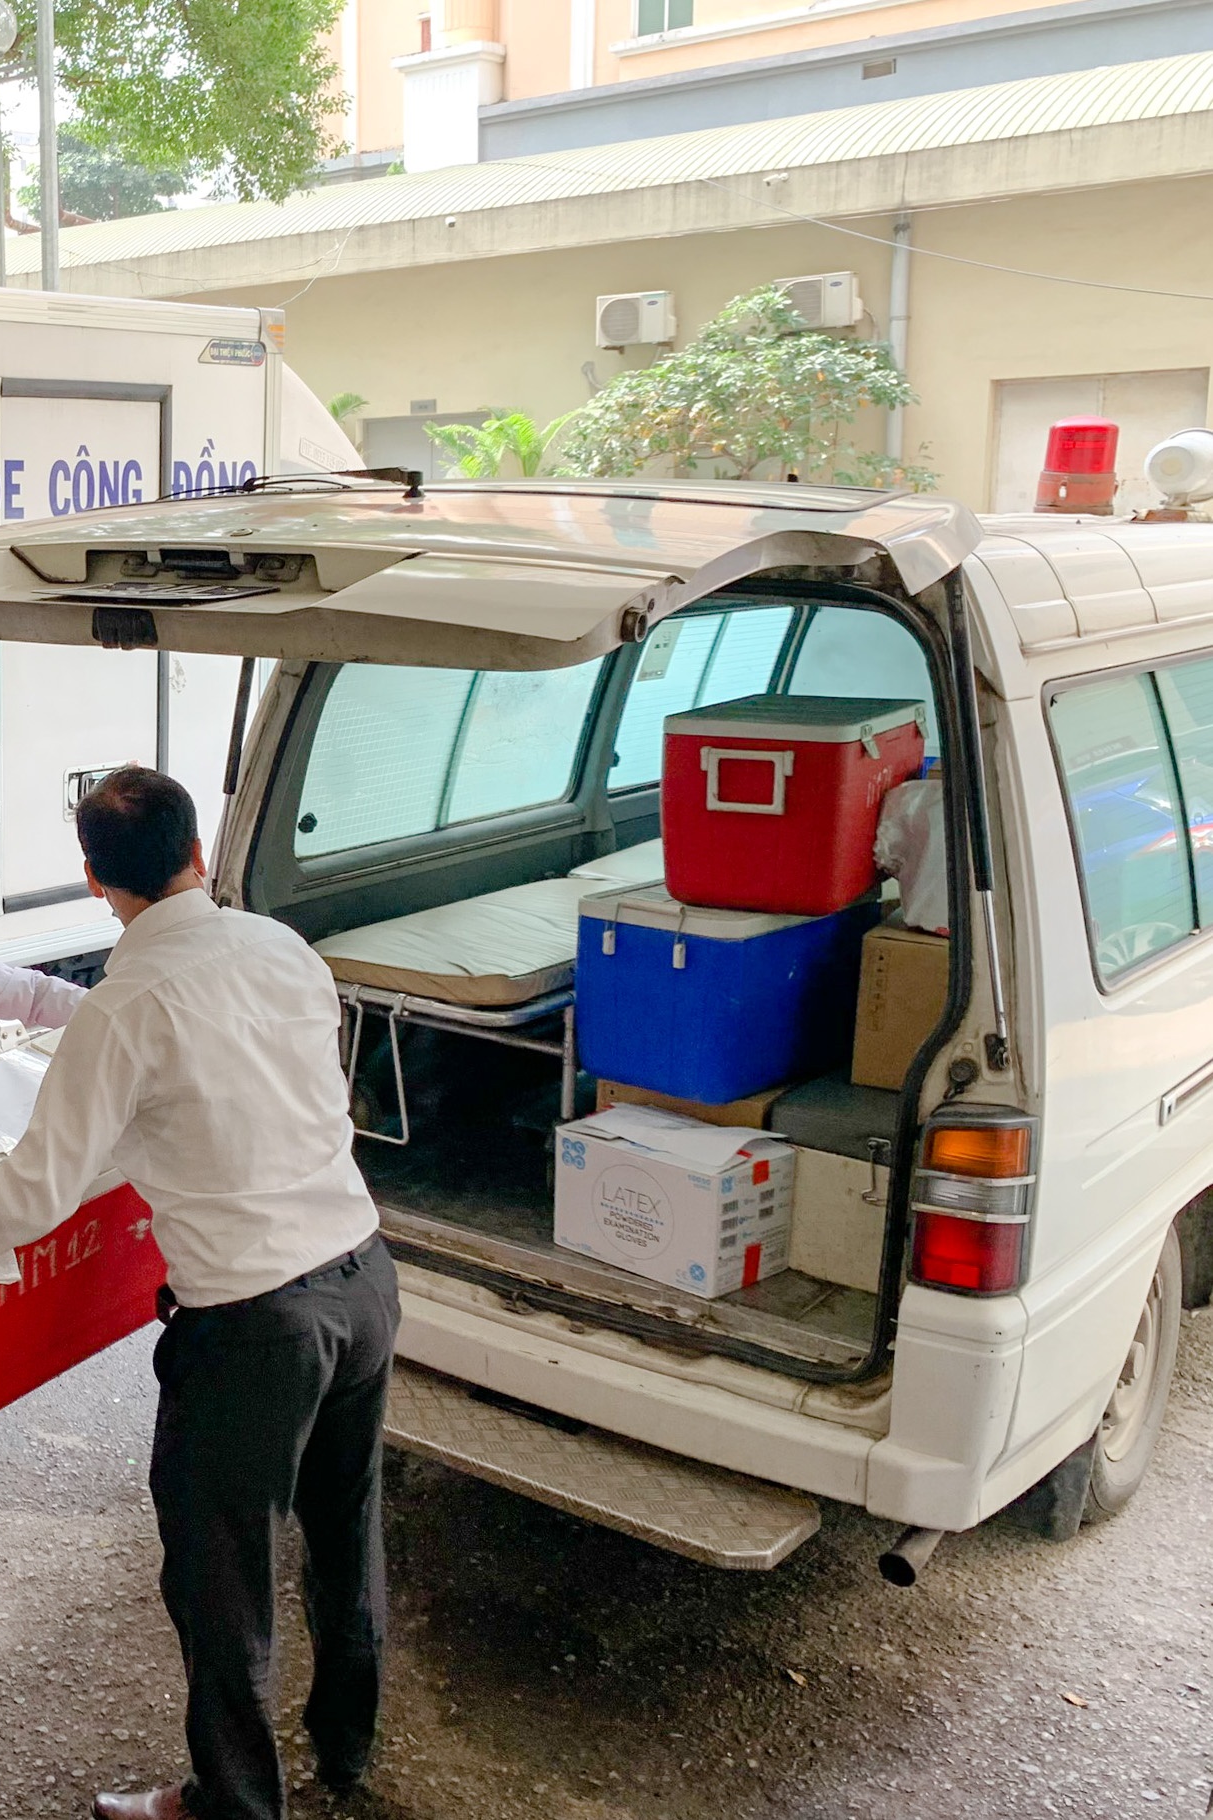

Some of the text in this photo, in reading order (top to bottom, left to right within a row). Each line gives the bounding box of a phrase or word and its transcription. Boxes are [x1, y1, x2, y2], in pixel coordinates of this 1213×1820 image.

[602, 1181, 661, 1218] LATEX
[603, 1217, 661, 1242] EXAMINATION
[609, 1211, 654, 1232] POWDERED
[615, 1231, 648, 1248] GLOVES
